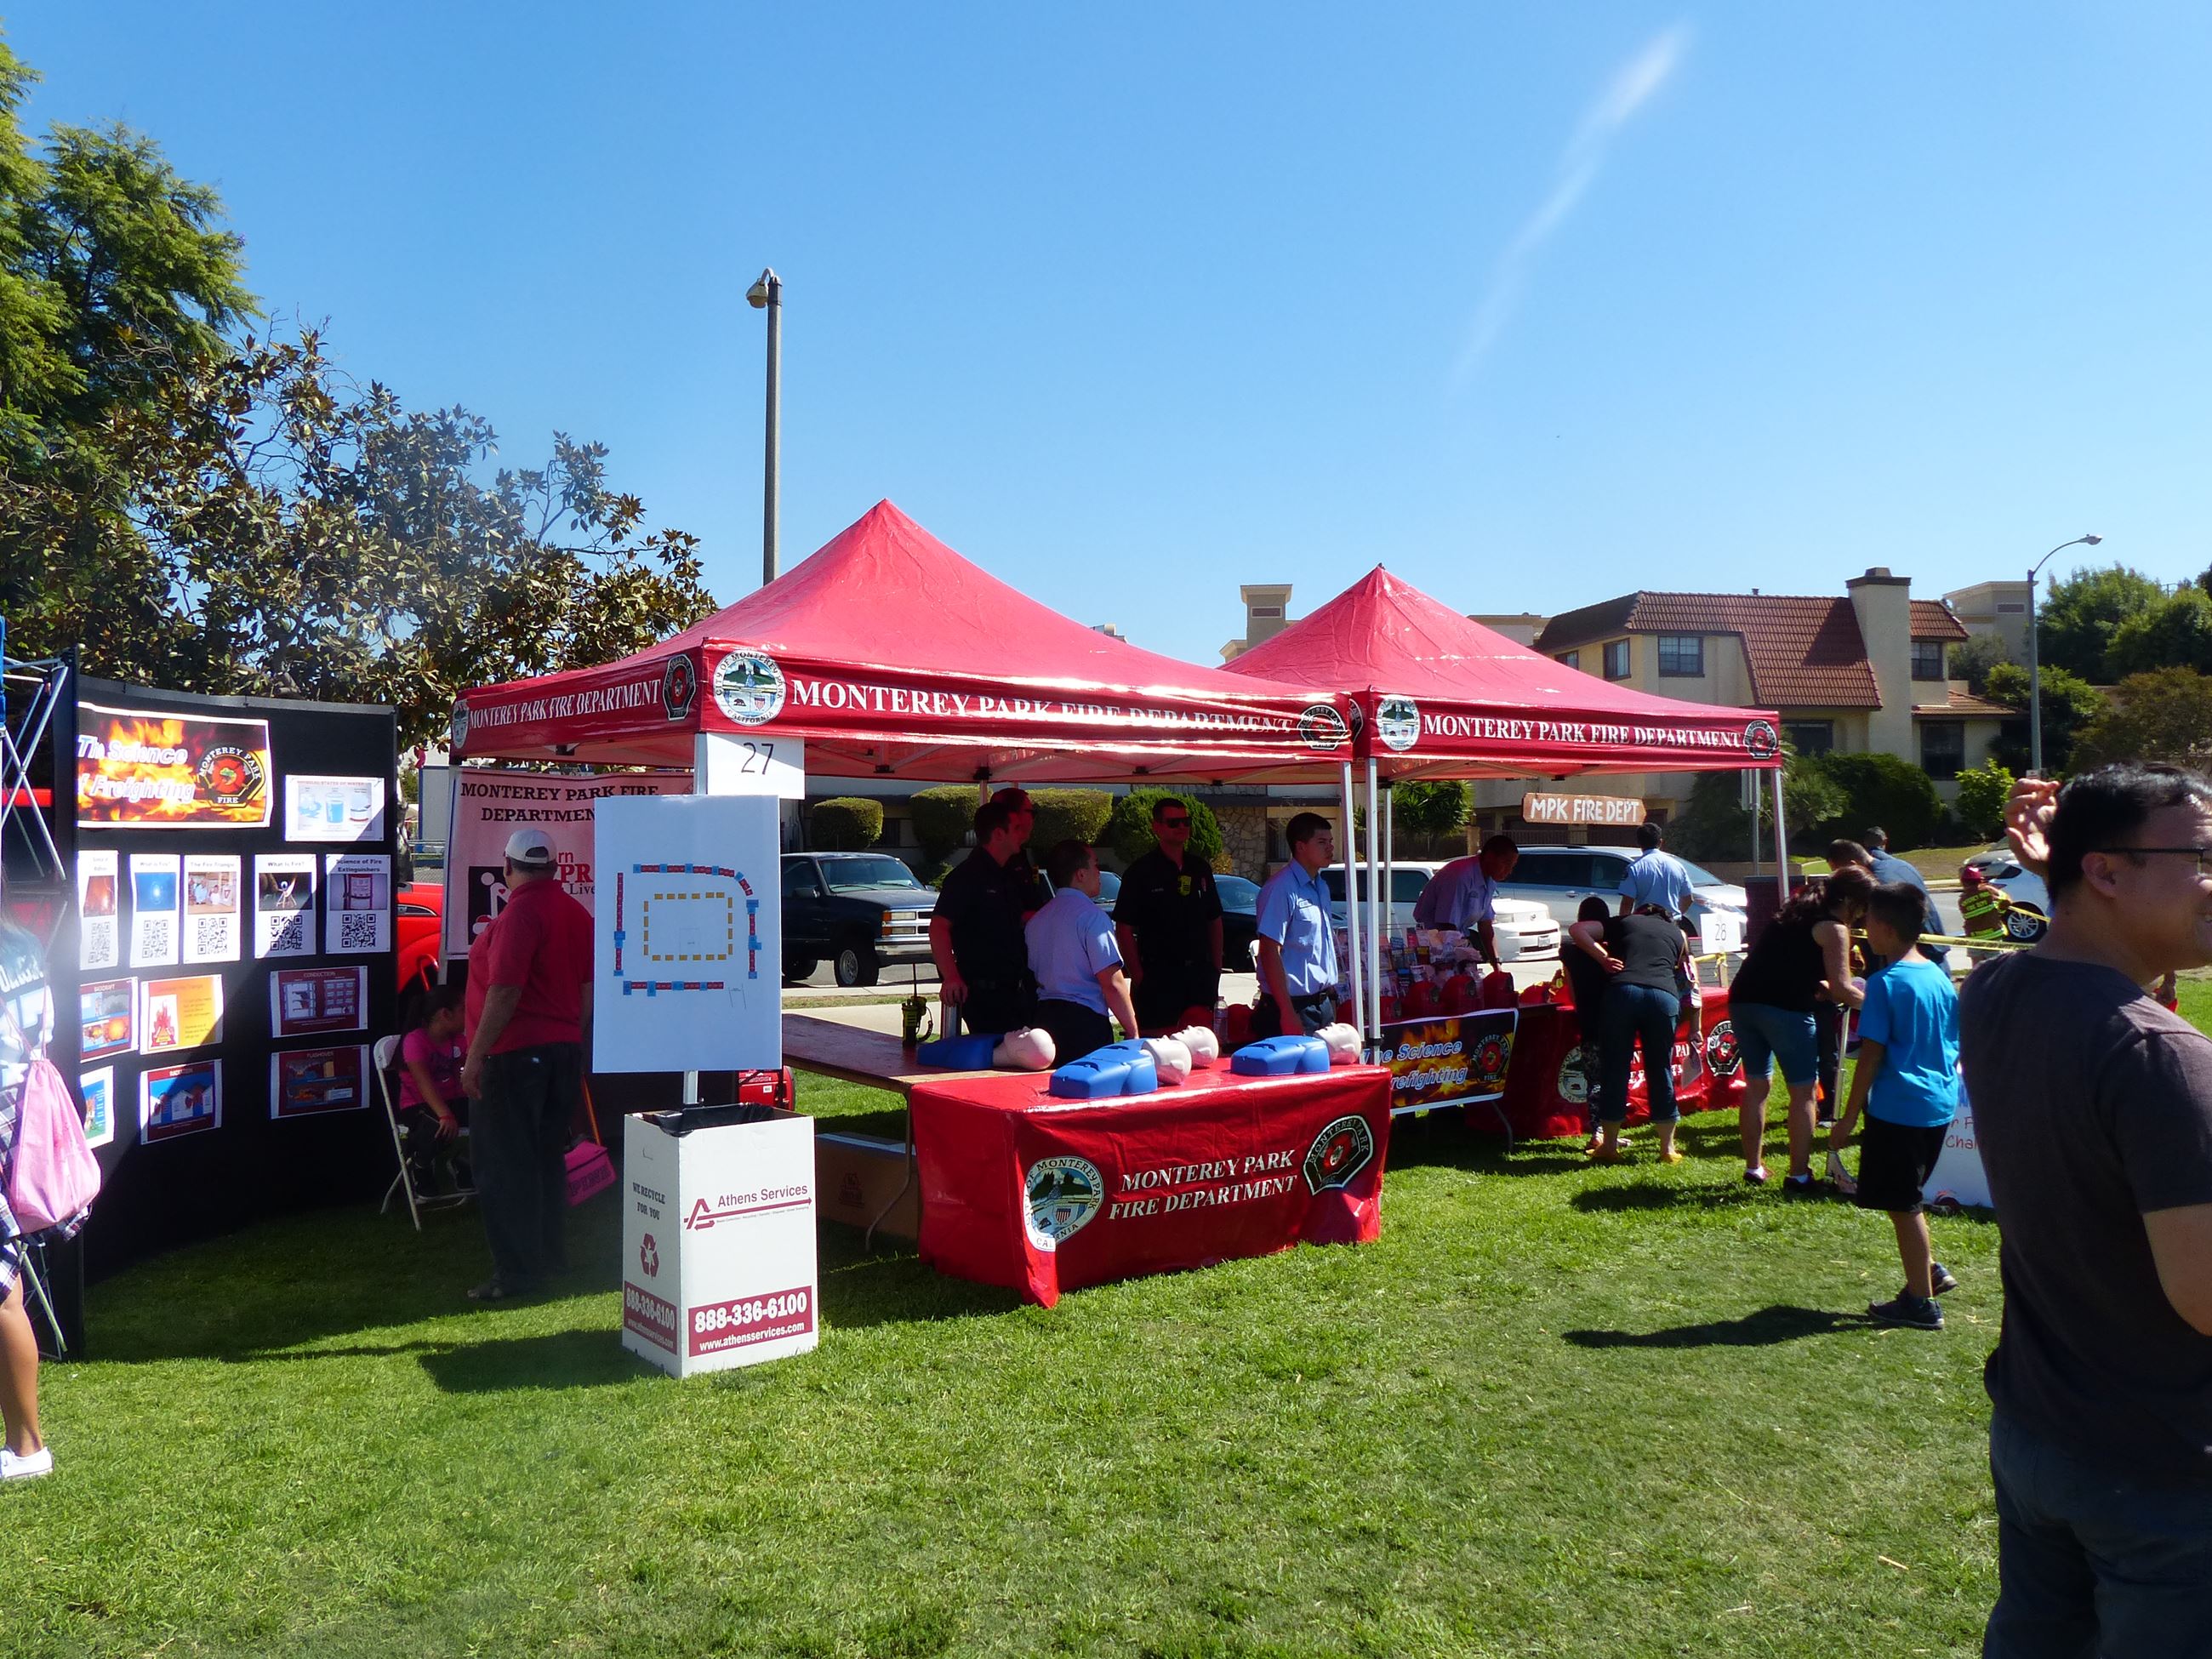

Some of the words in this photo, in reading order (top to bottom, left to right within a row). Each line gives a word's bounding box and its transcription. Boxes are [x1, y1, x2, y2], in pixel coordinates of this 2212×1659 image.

[715, 672, 723, 696] CITY
[720, 659, 730, 670] OF
[731, 652, 778, 674] MONTEREY
[469, 703, 517, 728] MONTEREY
[520, 698, 550, 721] PARK
[550, 694, 575, 717] FIRE
[577, 679, 660, 715] DEPARTMENT
[727, 709, 773, 723] CALIFORNIA
[791, 679, 971, 716] MONTEREY
[978, 695, 1052, 720] PARK
[1059, 702, 1120, 725] FIRE
[1128, 707, 1293, 733] DEPARTMENT
[1423, 714, 1534, 739] MONTEREY
[1538, 721, 1588, 743] PARK
[1590, 724, 1629, 744] FIRE
[1633, 727, 1742, 748] DEPARTMENT
[198, 747, 242, 777] MONTEREY
[244, 753, 261, 779] PARK
[741, 742, 774, 775] 27
[460, 783, 562, 801] MONTEREY
[565, 785, 616, 801] PARK
[620, 785, 659, 796] FIRE
[481, 807, 596, 822] DEPARTMEN
[1531, 798, 1568, 821] MPK
[1573, 798, 1603, 822] FIRE
[1605, 800, 1639, 823] DEPT
[560, 864, 594, 883] PR
[569, 882, 596, 895] Live
[1715, 923, 1726, 941] 28
[1363, 1047, 1393, 1063] Te
[1397, 1040, 1462, 1060] Science
[1390, 1067, 1468, 1091] refighting
[1026, 1172, 1034, 1189] OF
[1036, 1159, 1097, 1181] MONTEREY
[1088, 1183, 1101, 1210] PARK
[1120, 1158, 1240, 1192] MONTEREY
[1243, 1149, 1296, 1174] PARK
[632, 1182, 641, 1194] WE
[641, 1185, 665, 1205] RECYCLE
[717, 1191, 757, 1208] Athens
[761, 1184, 808, 1200] Services
[1109, 1197, 1160, 1220] FIRE
[1164, 1175, 1297, 1213] DEPARTMENT
[637, 1201, 647, 1215] FOR
[649, 1206, 660, 1220] YOU
[626, 1286, 675, 1331] 888-336-6100
[695, 1291, 807, 1333] 888-336-6100
[699, 1321, 805, 1352] www.athensservices.com
